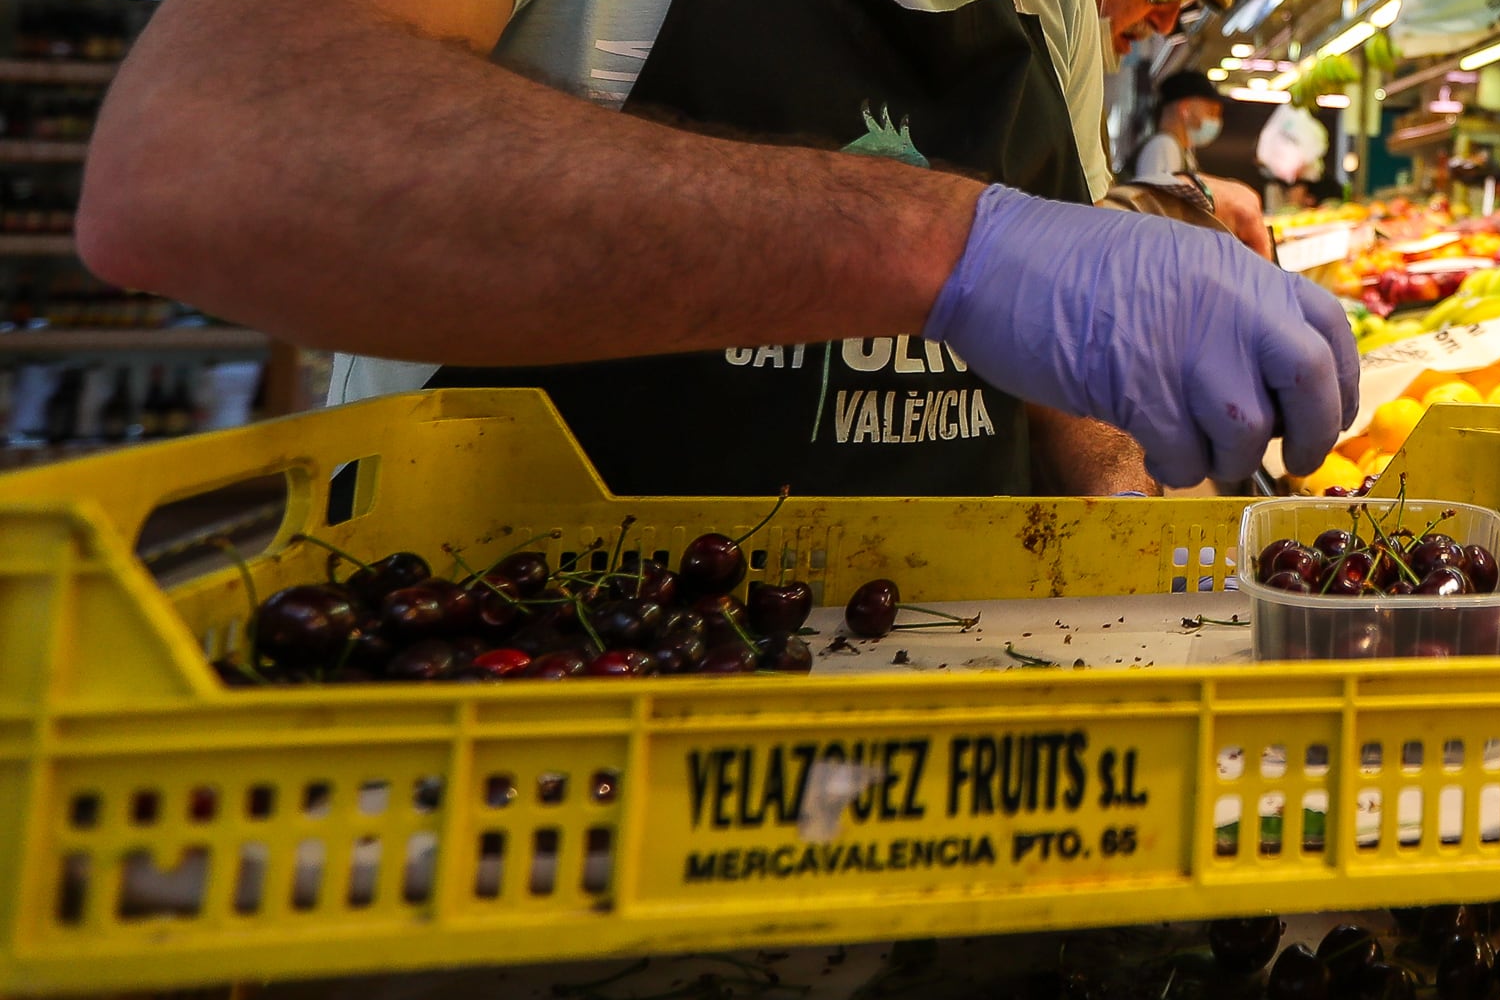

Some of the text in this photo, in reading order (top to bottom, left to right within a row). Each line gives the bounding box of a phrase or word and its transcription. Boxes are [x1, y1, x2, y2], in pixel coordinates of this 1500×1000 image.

[835, 389, 995, 443] VALÈNCIA
[946, 728, 1089, 819] FRUITS
[684, 825, 1137, 886] MERCAVALENCIA PTO. 65
